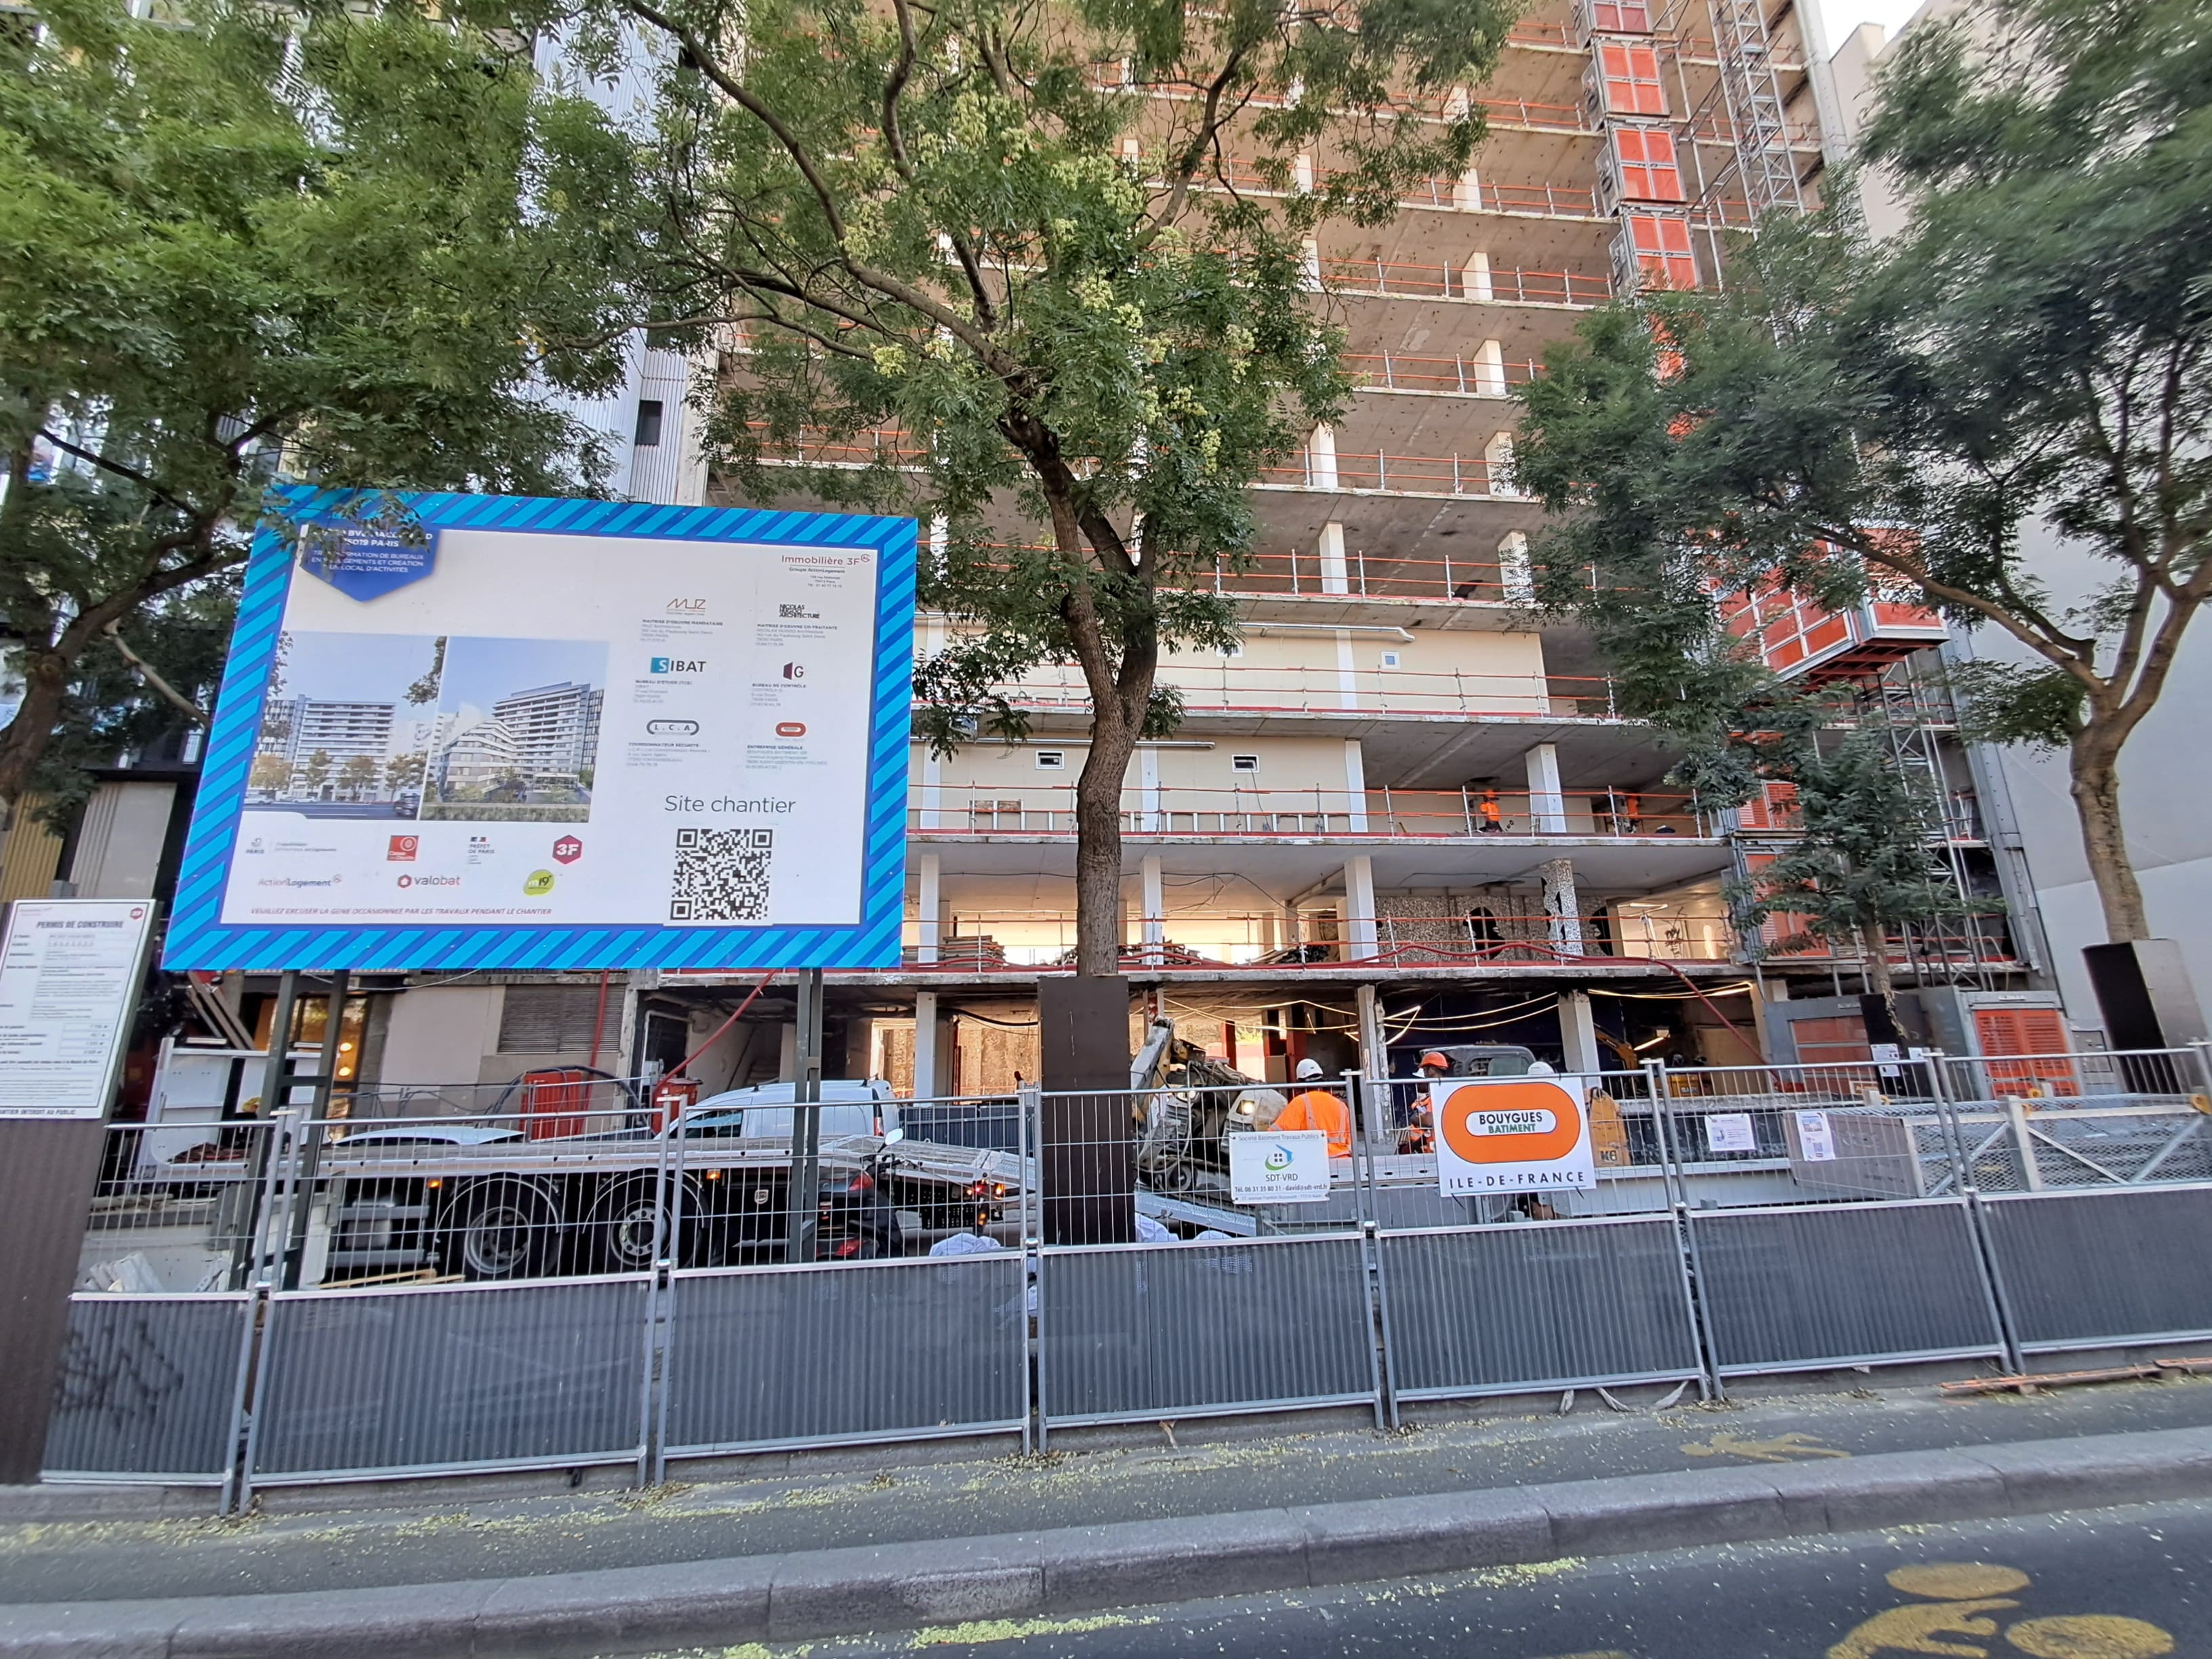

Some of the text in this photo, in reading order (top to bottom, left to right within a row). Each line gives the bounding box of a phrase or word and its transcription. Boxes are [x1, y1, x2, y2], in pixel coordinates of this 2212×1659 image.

[371, 539, 399, 548] PARIS
[781, 554, 844, 565] Immobilière
[846, 557, 860, 565] 3F
[658, 659, 707, 673] SIBAT
[664, 795, 796, 814] Site chantier
[556, 843, 580, 856] 3F
[258, 878, 331, 888] ActionLogement
[414, 875, 461, 886] valobat
[1479, 1111, 1543, 1126] BOUYGUES
[1488, 1124, 1536, 1134] BATIMENT
[1265, 1173, 1298, 1183] SDT-VRD
[1449, 1171, 1584, 1189] ILE-DE-FRANCE
[1285, 1183, 1328, 1191] david@sdt-vrd.fr
